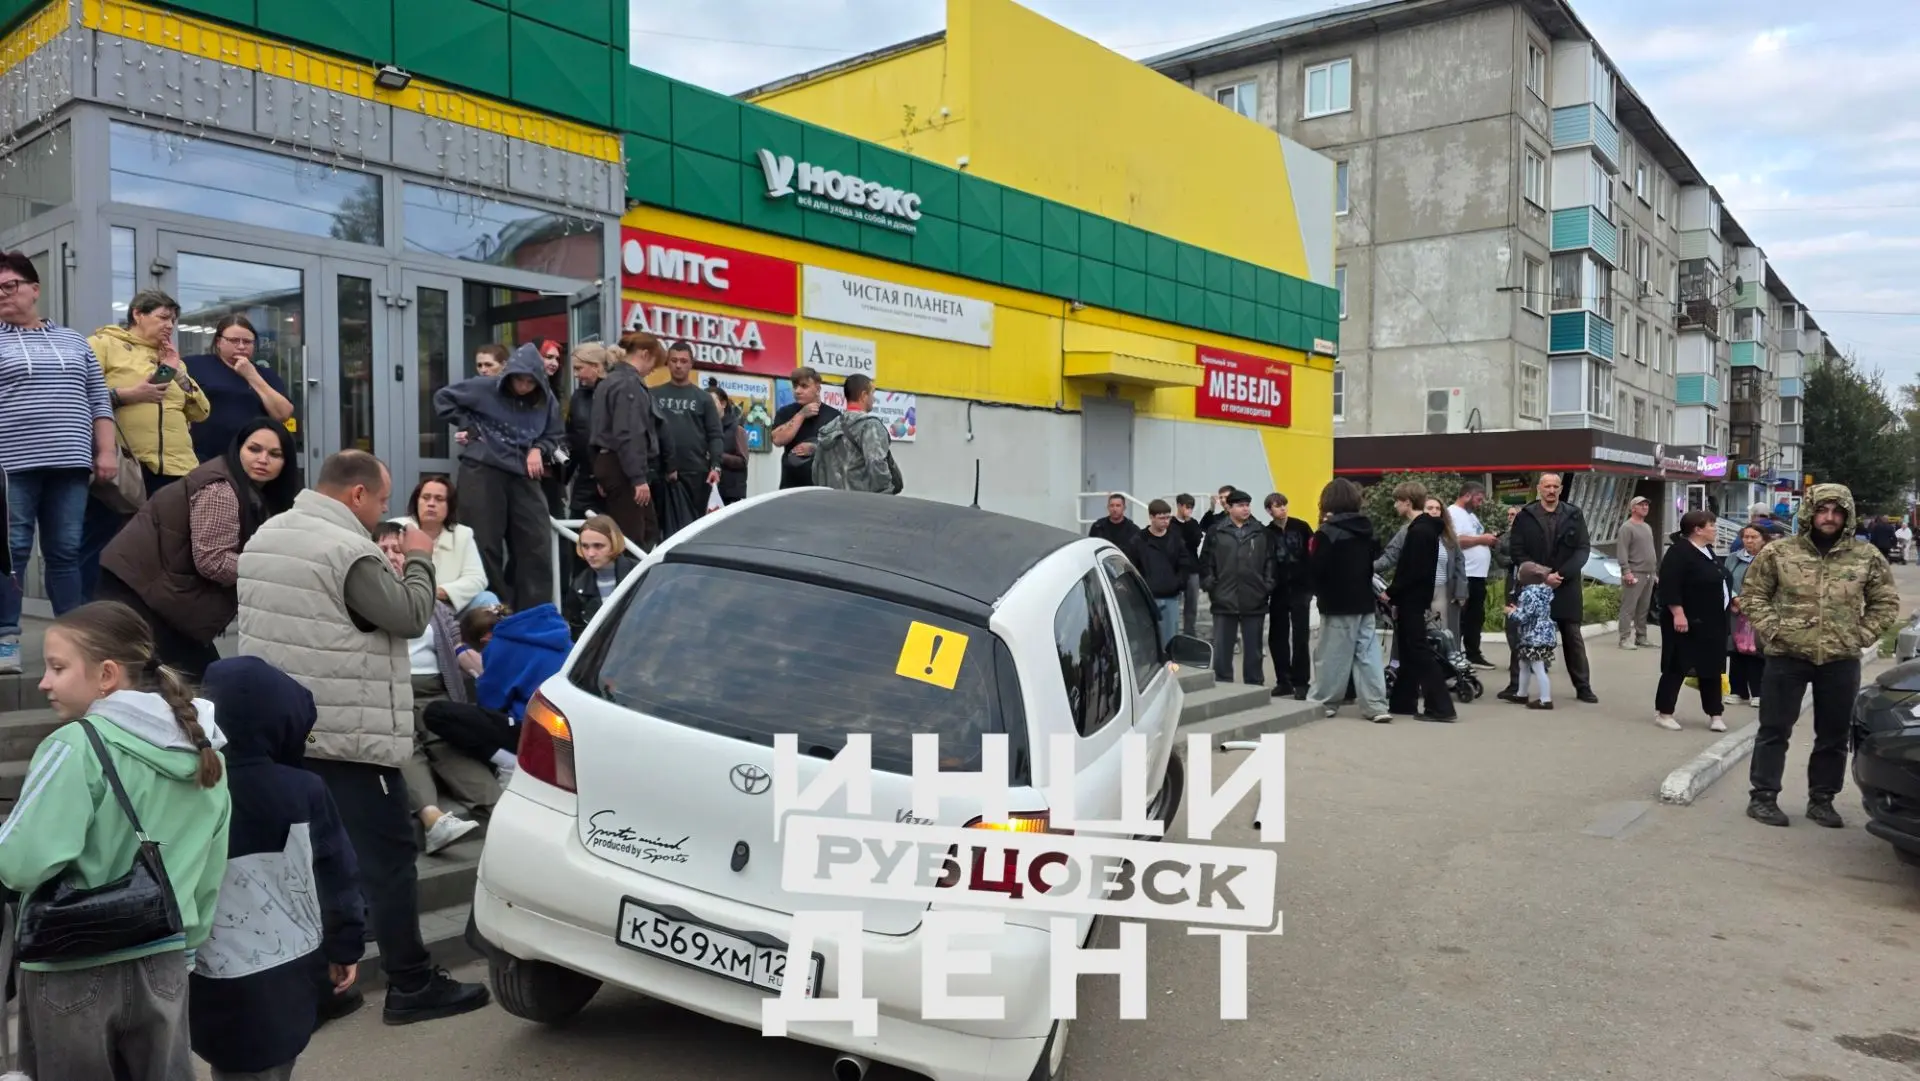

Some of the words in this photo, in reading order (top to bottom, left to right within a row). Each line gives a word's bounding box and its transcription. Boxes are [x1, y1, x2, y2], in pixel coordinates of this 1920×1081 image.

[797, 162, 922, 221] НОВЭКС
[813, 201, 829, 210] для
[830, 203, 853, 216] ухода
[854, 211, 863, 219] за
[864, 213, 886, 225] собой
[893, 222, 917, 232] домом
[647, 244, 729, 289] МТС
[842, 279, 899, 305] ЧИСТАЯ
[903, 292, 964, 317] ПЛАНЕТА
[625, 302, 766, 350] АПТЕКА
[808, 340, 872, 371] Ателье
[718, 380, 768, 393] ИЦЕНЗИЕЙ
[1209, 370, 1281, 406] МЕБЕЛЬ
[659, 397, 697, 411] STYLE
[1221, 403, 1229, 412] ОТ
[593, 837, 631, 853] produced
[632, 844, 642, 857] by
[642, 848, 690, 863] Sports
